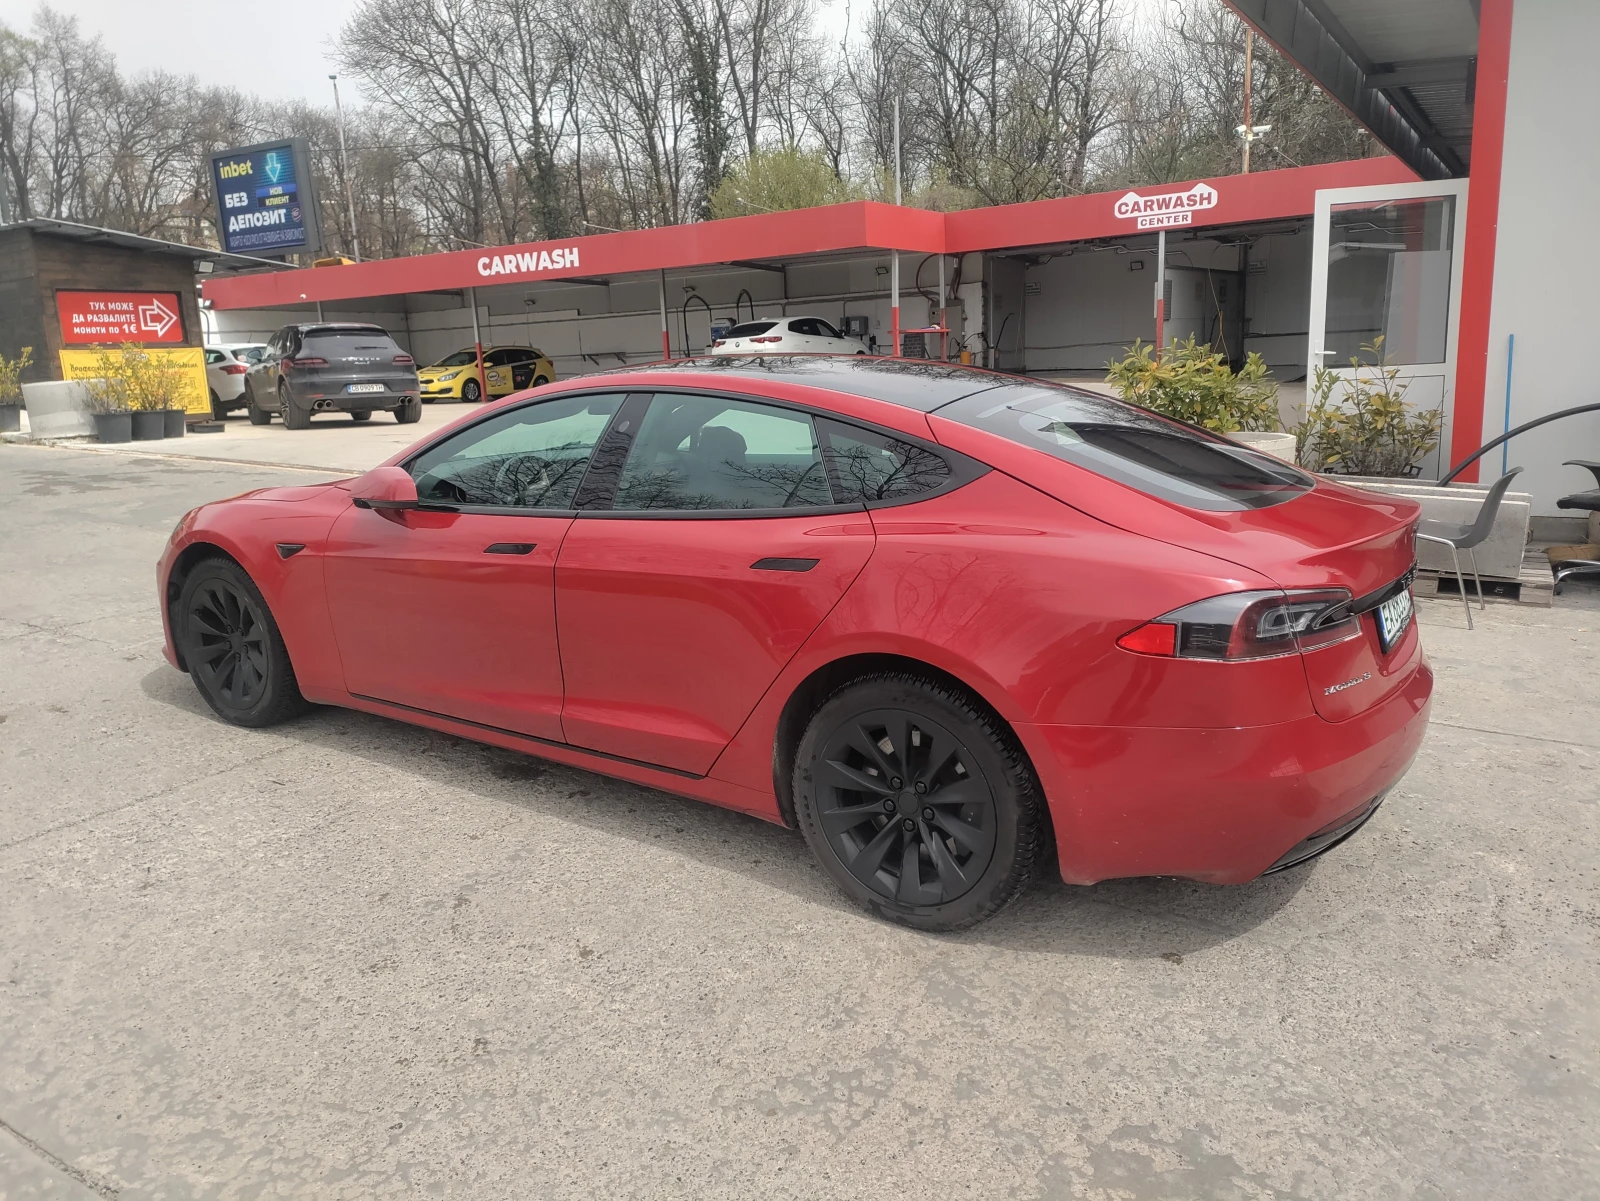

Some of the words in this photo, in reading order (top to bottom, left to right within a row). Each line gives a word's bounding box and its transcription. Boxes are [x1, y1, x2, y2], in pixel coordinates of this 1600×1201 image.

[219, 159, 253, 179] inbet
[269, 186, 283, 196] НОВ
[224, 191, 249, 208] БЕЗ
[265, 195, 290, 206] КЛИЕНТ
[1117, 191, 1212, 215] CARWASH
[228, 208, 287, 233] ДЕПОЗИТ
[1140, 213, 1189, 227] CENTER
[477, 247, 580, 276] CARWASH
[89, 301, 106, 311] ТУК
[107, 301, 134, 311] МОЖЕ
[72, 313, 84, 324] ДА
[87, 314, 136, 323] РАЗВАЛИТЕ
[122, 323, 138, 335] 1€
